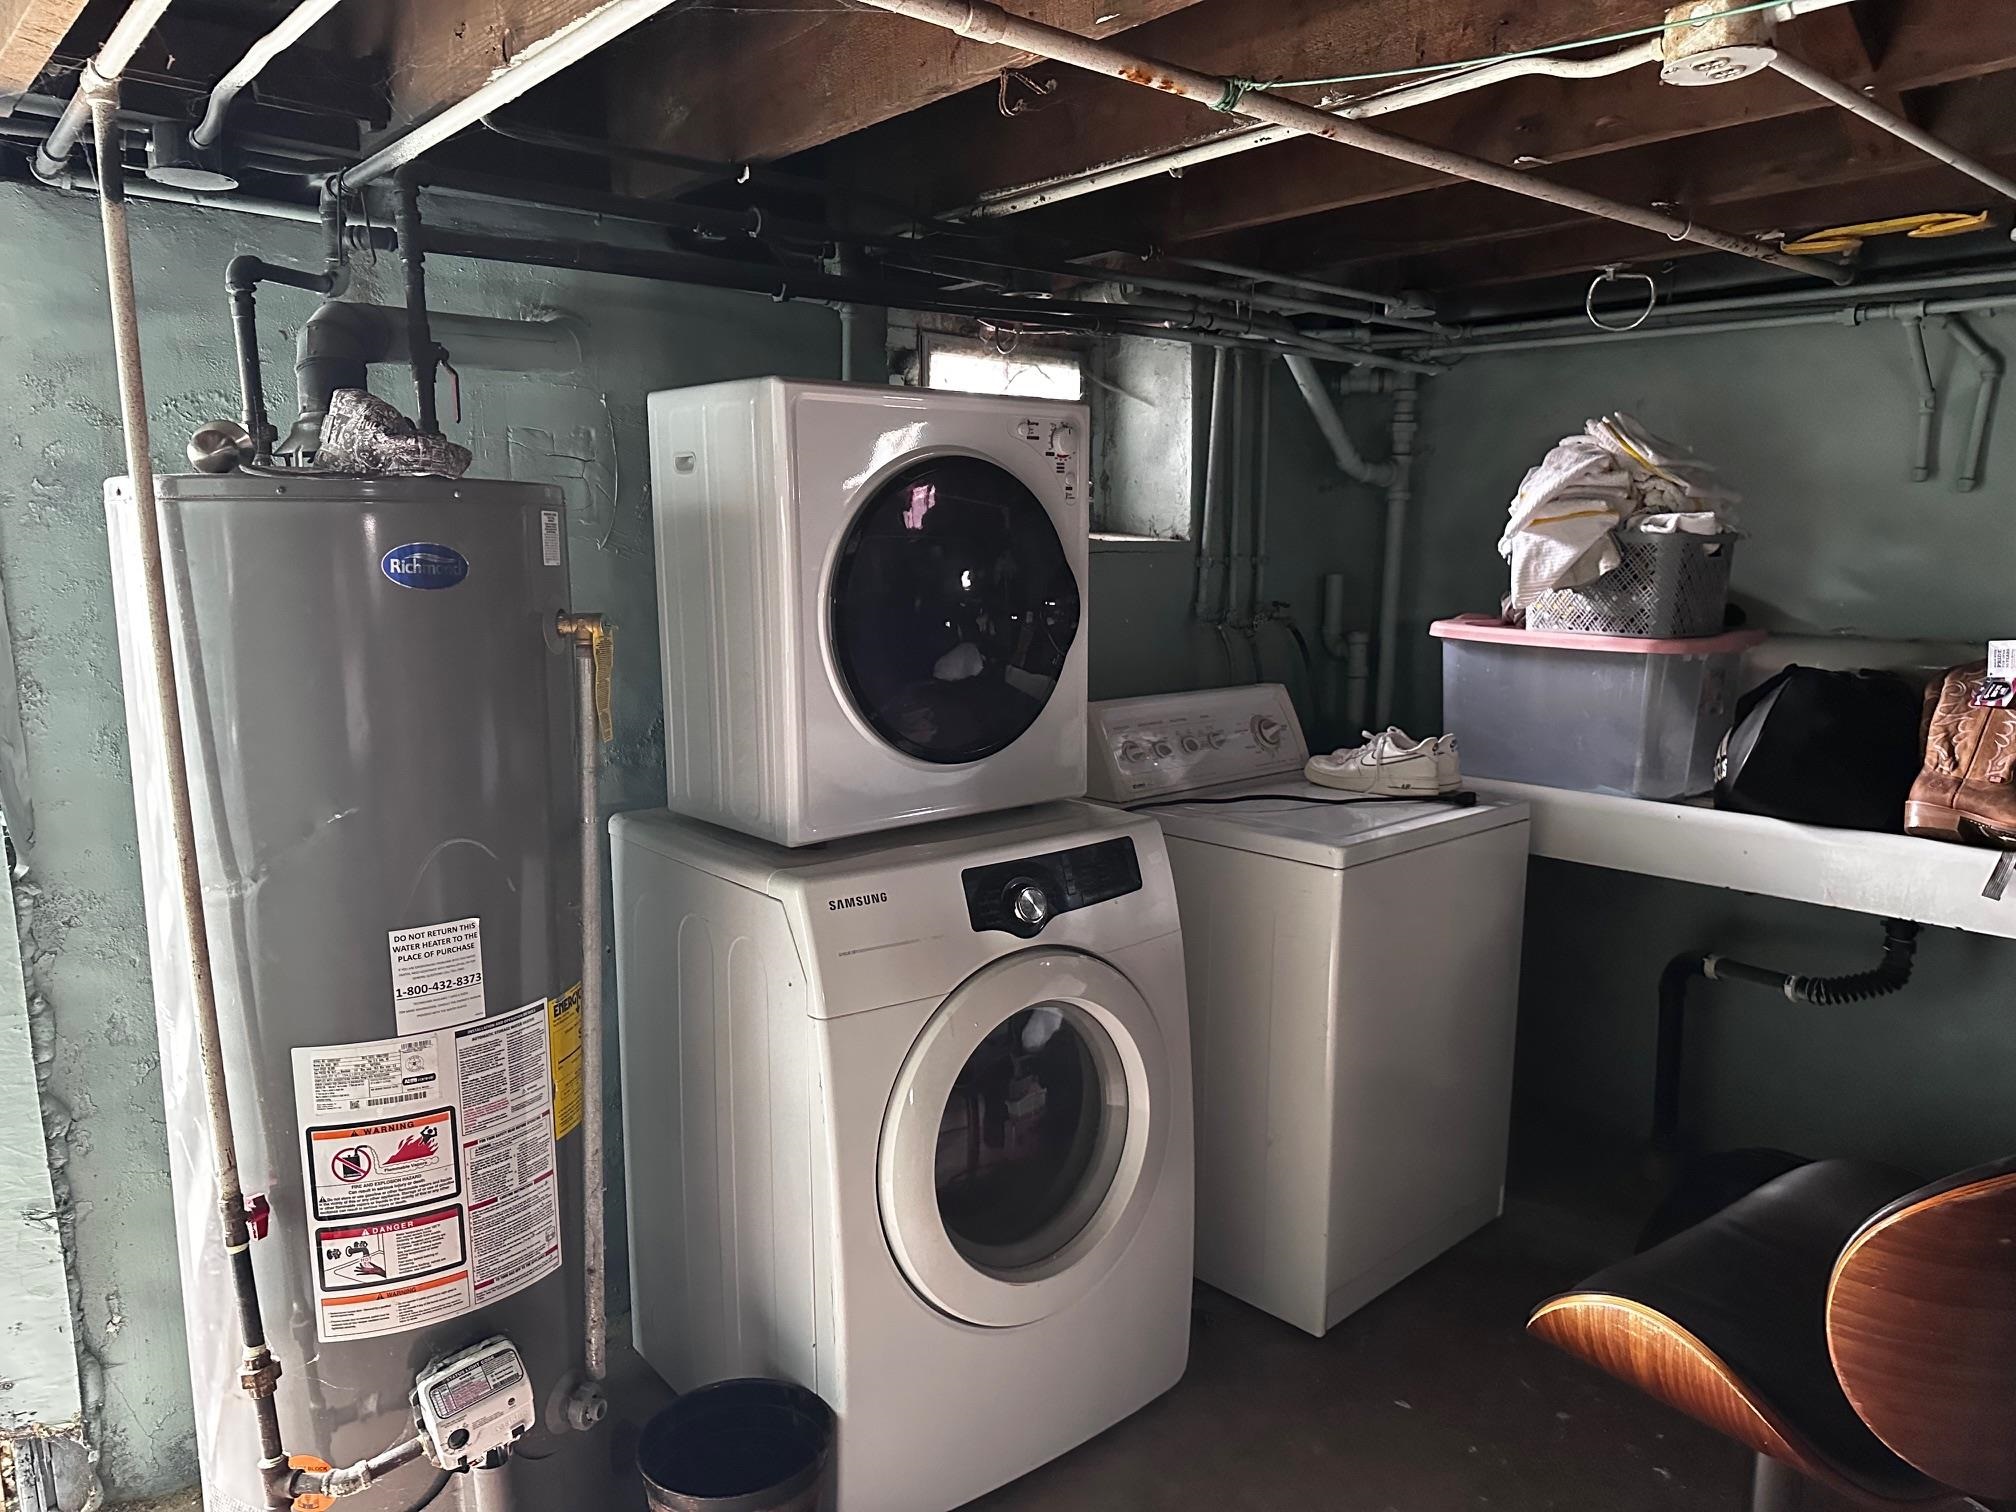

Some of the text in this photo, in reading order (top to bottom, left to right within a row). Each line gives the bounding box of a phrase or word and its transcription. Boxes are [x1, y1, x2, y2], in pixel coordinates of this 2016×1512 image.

[390, 558, 462, 576] Richmond
[828, 892, 888, 911] SAMSUNG
[408, 932, 425, 940] NOT
[427, 926, 458, 937] RETURN
[459, 922, 476, 931] THIS
[392, 943, 420, 953] WATER
[422, 938, 451, 948] HEATER
[398, 953, 422, 962] PLACE
[436, 942, 475, 956] PURCHASE
[396, 973, 482, 998] 1-800-432-8373
[364, 1121, 415, 1135] WARNING
[372, 1221, 414, 1234] DANGER
[386, 1287, 416, 1298] WARNING
